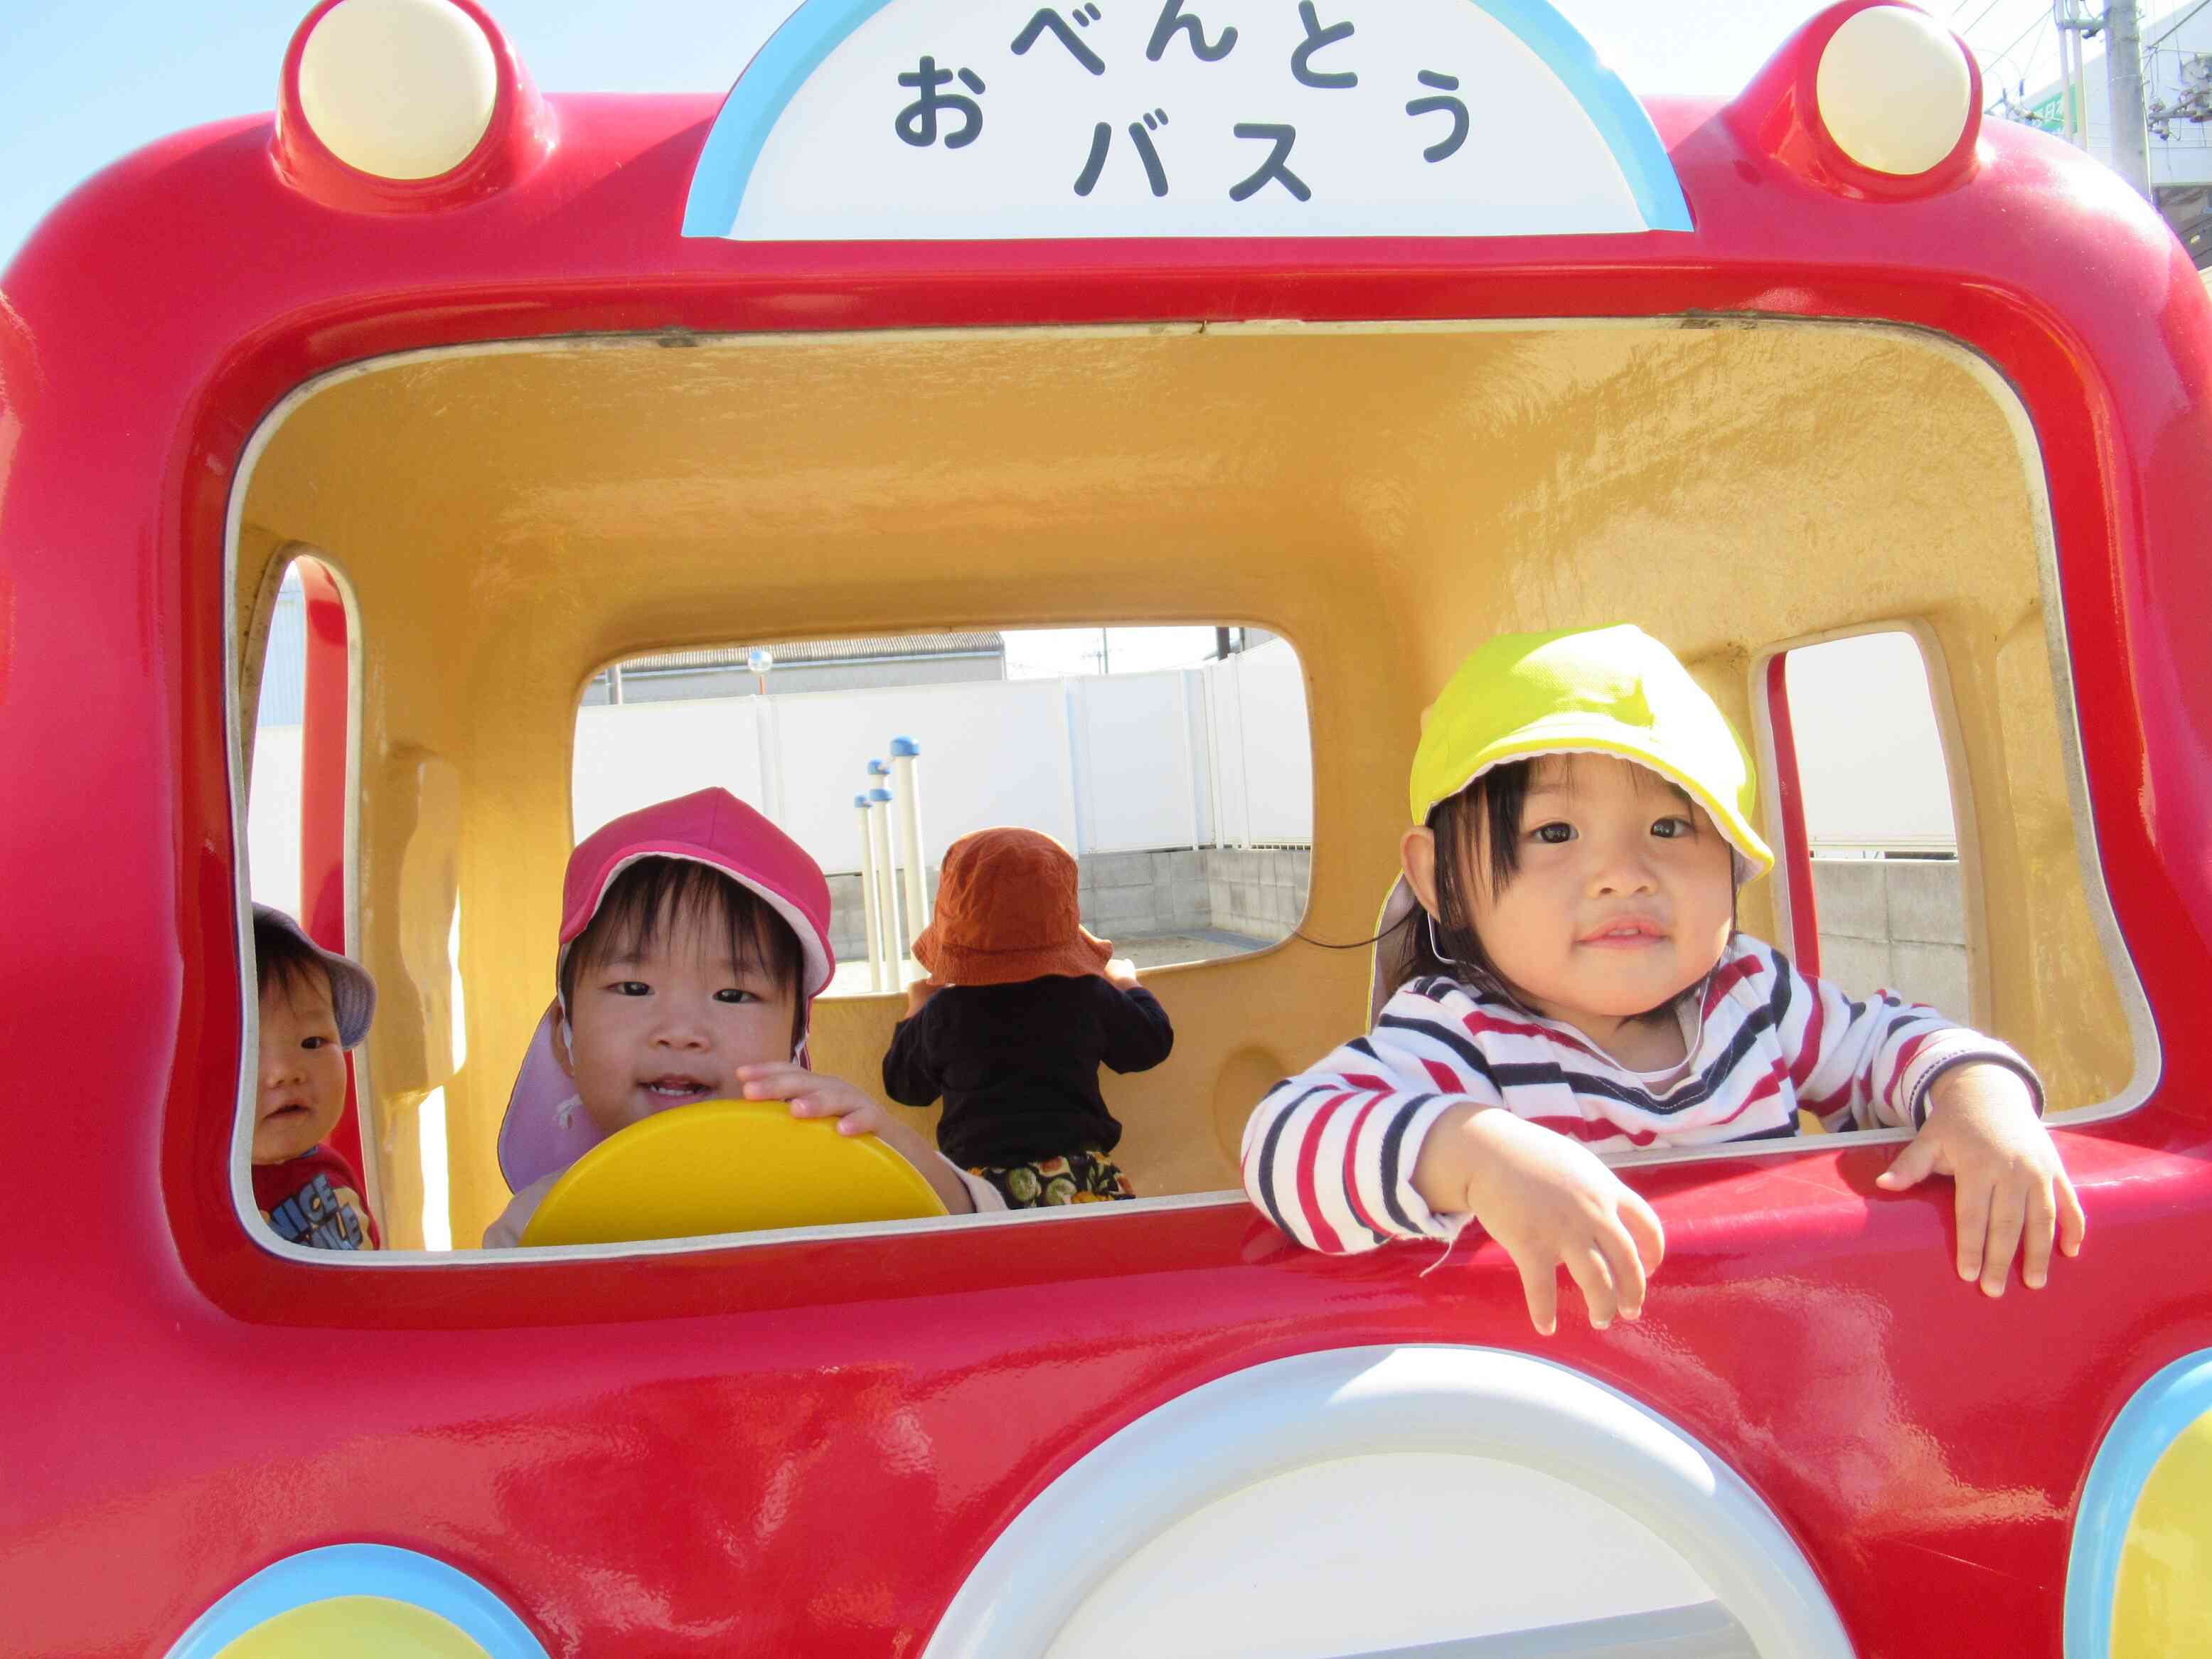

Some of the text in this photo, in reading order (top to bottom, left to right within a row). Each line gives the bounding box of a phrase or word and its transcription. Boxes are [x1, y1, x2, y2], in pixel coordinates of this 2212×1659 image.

[894, 0, 1470, 163] おべんとう
[1073, 107, 1312, 202] バス
